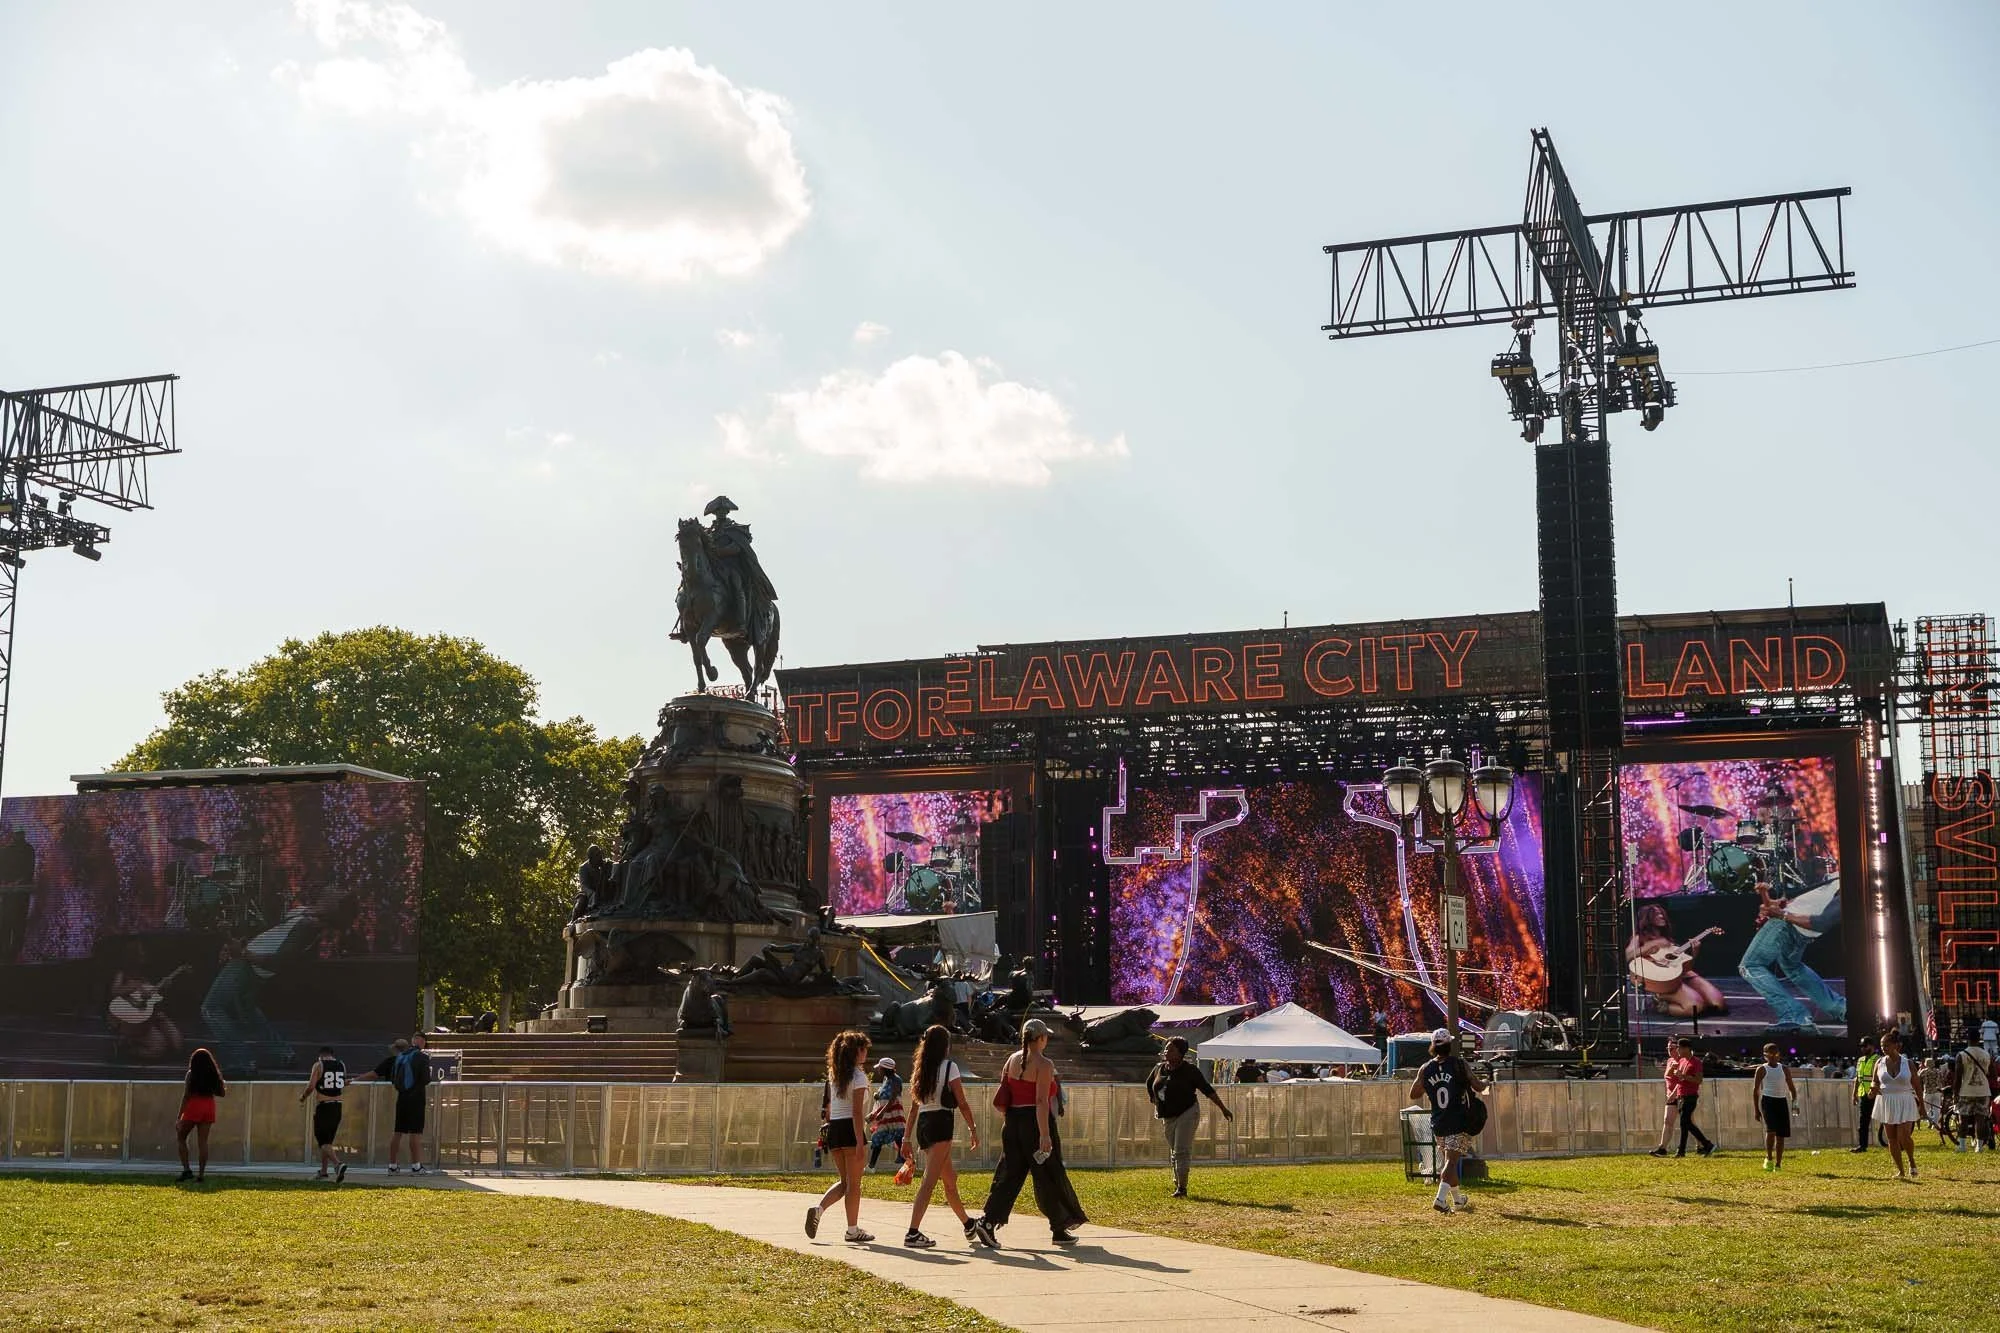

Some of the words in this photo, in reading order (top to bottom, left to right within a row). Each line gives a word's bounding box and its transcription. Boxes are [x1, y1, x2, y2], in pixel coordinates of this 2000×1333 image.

[944, 643, 1284, 714] ELAWARE
[1303, 629, 1479, 697] CITY
[1626, 634, 1847, 698] LAND
[777, 687, 976, 744] TFOR
[1453, 920, 1464, 945] C-1
[323, 1071, 345, 1089] 25
[1436, 1086, 1449, 1109] 0
